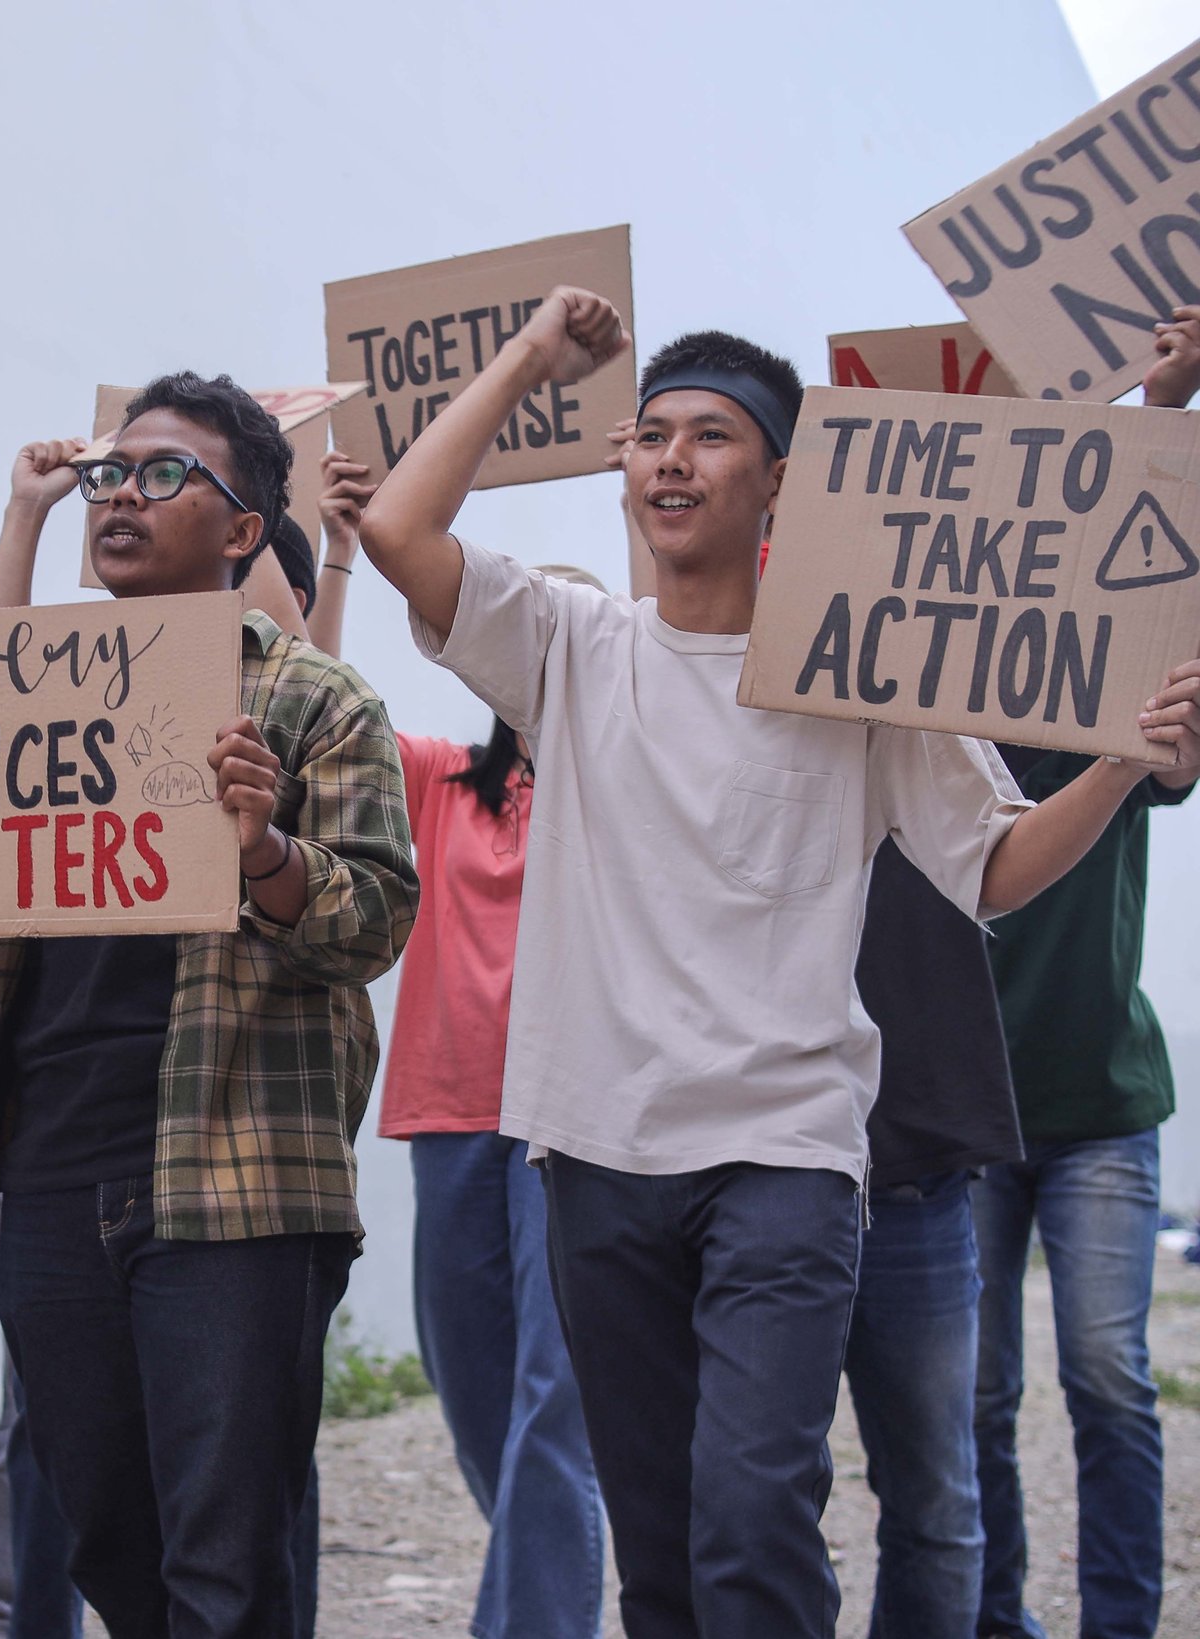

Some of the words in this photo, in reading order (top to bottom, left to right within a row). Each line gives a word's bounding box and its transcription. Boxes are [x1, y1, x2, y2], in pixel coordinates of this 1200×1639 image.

[347, 297, 544, 398] TOGETH
[495, 380, 581, 453] ISE
[822, 417, 982, 501] TIME
[1010, 428, 1113, 514] TO
[883, 512, 1066, 598] TAKE
[795, 593, 1112, 728] ACTION
